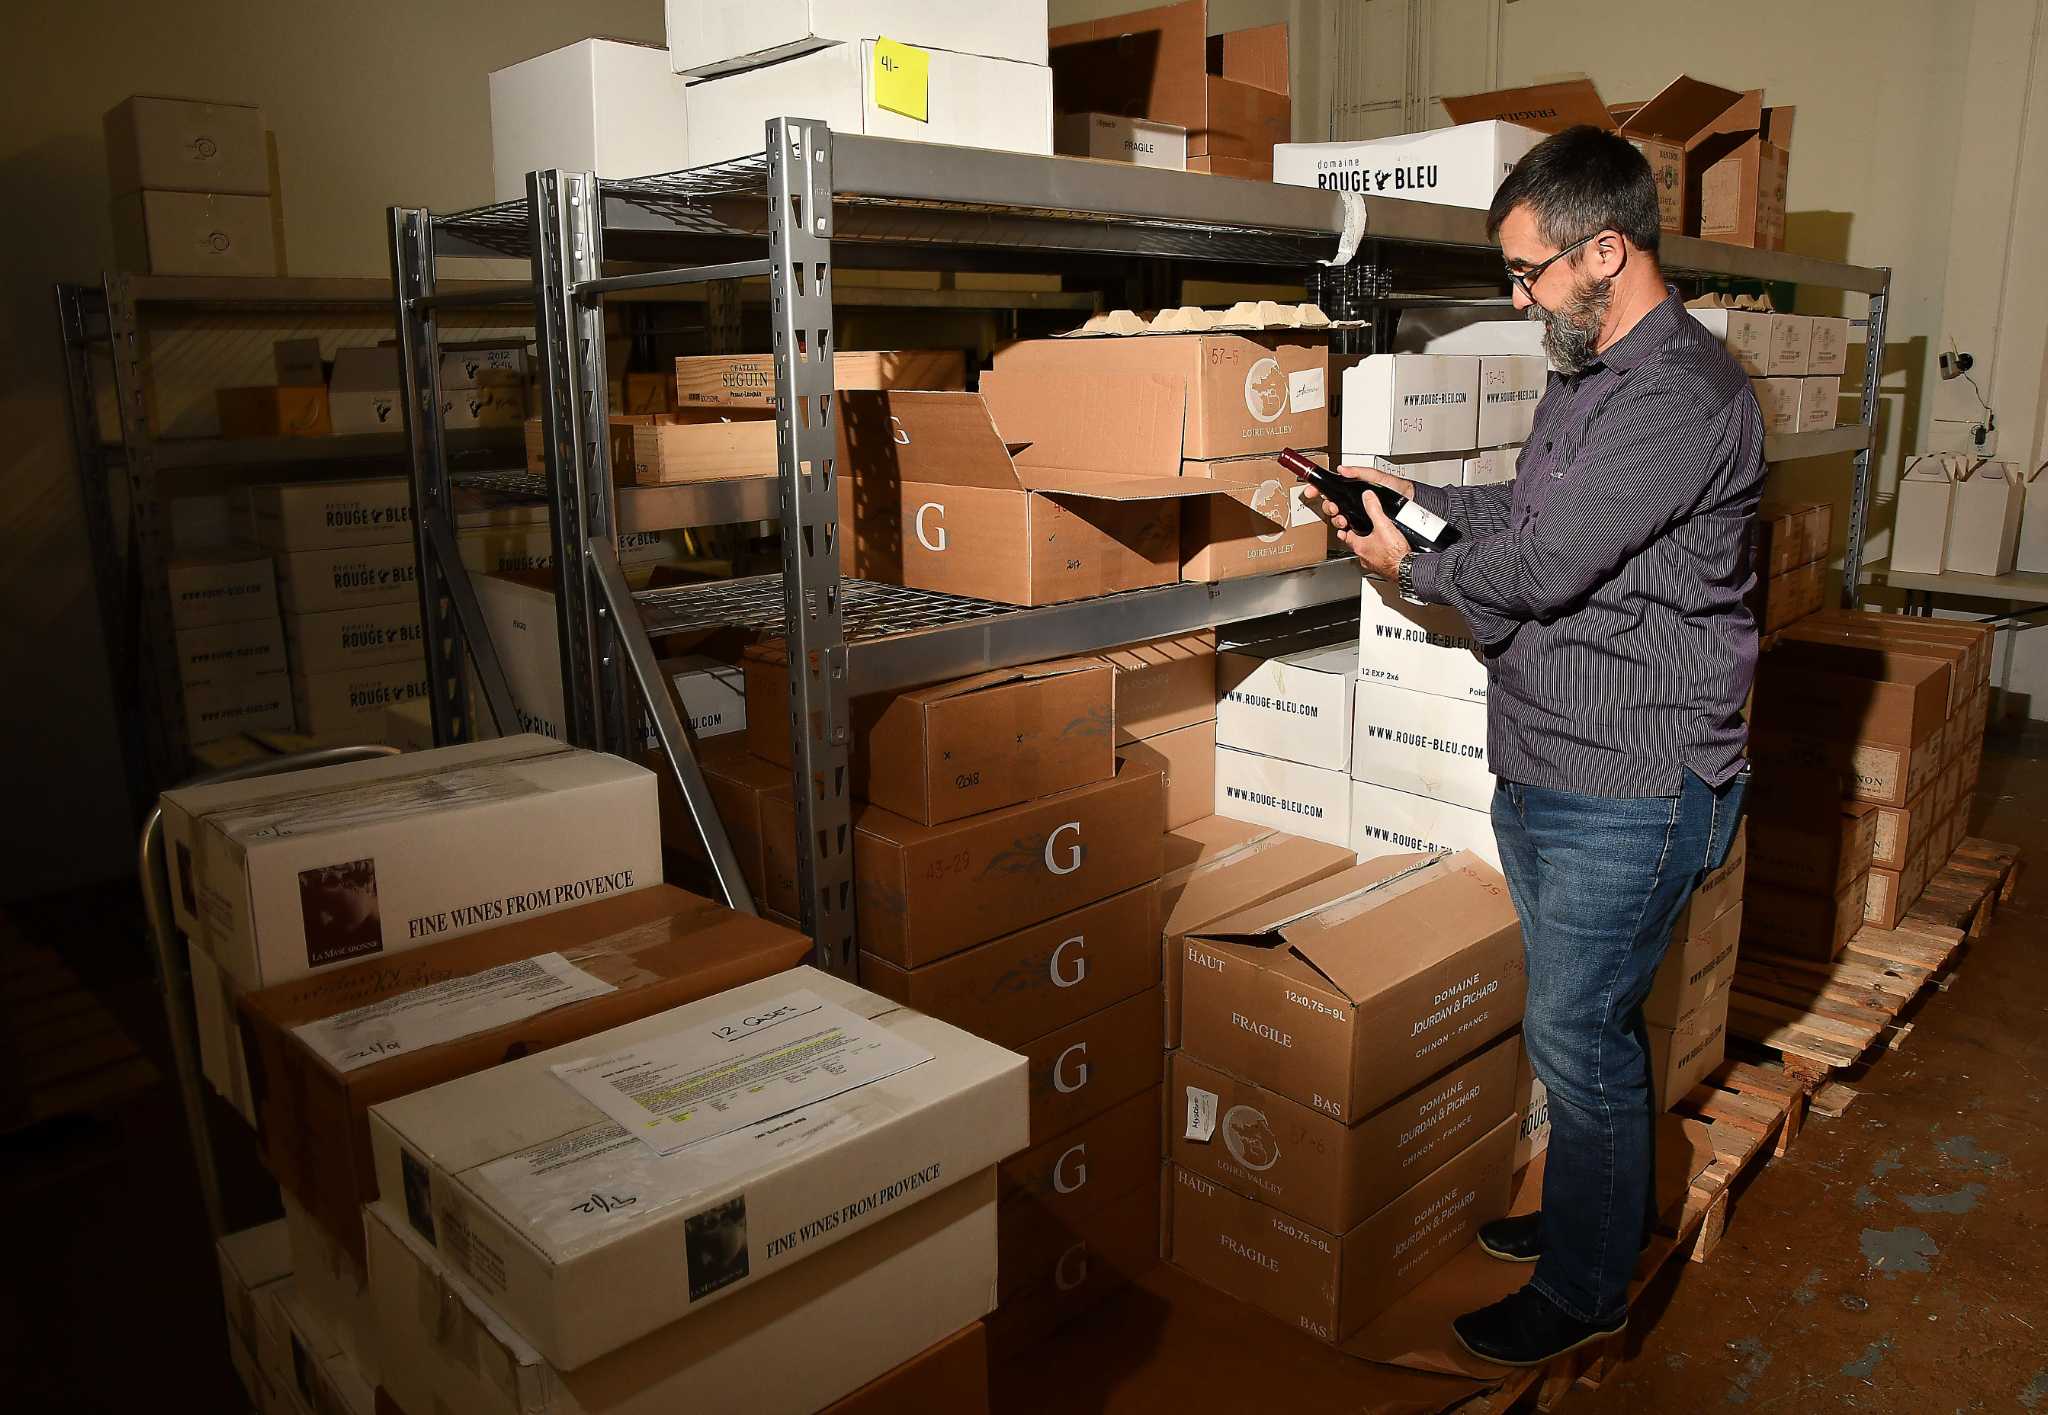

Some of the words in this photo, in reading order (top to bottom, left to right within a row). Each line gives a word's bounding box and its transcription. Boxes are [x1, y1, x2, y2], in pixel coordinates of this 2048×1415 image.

[1124, 141, 1154, 153] FRAGILE
[1317, 158, 1360, 170] domaine
[1318, 170, 1370, 192] ROUGE
[1396, 165, 1438, 188] BLEU
[721, 372, 768, 387] SEGUIN
[1404, 393, 1467, 406] WWW.ROUGE-BLEU.COM
[386, 505, 412, 523] BLE
[916, 502, 946, 551] G
[392, 566, 414, 582] BLE
[400, 624, 422, 640] BLE
[407, 681, 428, 698] BLE
[1361, 667, 1370, 676] 12
[1386, 672, 1399, 681] 2x6
[1222, 690, 1318, 718] WWW.ROUGE-BLEU.COM
[1469, 687, 1486, 697] Poid
[1369, 725, 1484, 759] WWW.ROUGE-BLEU.COM
[1226, 786, 1323, 818] WWW.ROUGE-BLEU.COM
[1045, 821, 1081, 875] G
[408, 913, 448, 938] FINE
[451, 899, 502, 929] WINES
[506, 888, 552, 916] FROM
[555, 870, 634, 904] PROVENCE
[1050, 936, 1086, 988] G
[1188, 948, 1225, 973] HAUT
[1285, 990, 1346, 1022] 12x0,75=9L
[1434, 973, 1480, 1006] DOMAINE
[1410, 1005, 1452, 1037] JOURDAN
[1462, 980, 1498, 1009] PICHARD
[712, 1026, 737, 1039] 12
[1232, 1012, 1292, 1048] FRAGILE
[1415, 1034, 1449, 1058] CHINON
[1458, 1012, 1489, 1033] FRANCE
[1053, 1042, 1087, 1094] G
[1312, 1093, 1341, 1116] BAS
[1419, 1080, 1464, 1116] DOMAINE
[1397, 1113, 1438, 1149] JOURDAN
[1447, 1085, 1480, 1116] PICHARD
[1520, 1104, 1547, 1141] ROUG
[1053, 1144, 1086, 1194] G
[1178, 1170, 1215, 1198] HAUT
[766, 1232, 797, 1258] FINE
[799, 1212, 840, 1242] WINES
[841, 1193, 877, 1223] FROM
[879, 1163, 942, 1204] PROVENCE
[1414, 1188, 1458, 1226] DOMAINE
[1393, 1223, 1431, 1259] JOURDAN
[1441, 1191, 1475, 1223] PICHARD
[1055, 1240, 1087, 1290] G
[1219, 1233, 1280, 1272] FRAGILE
